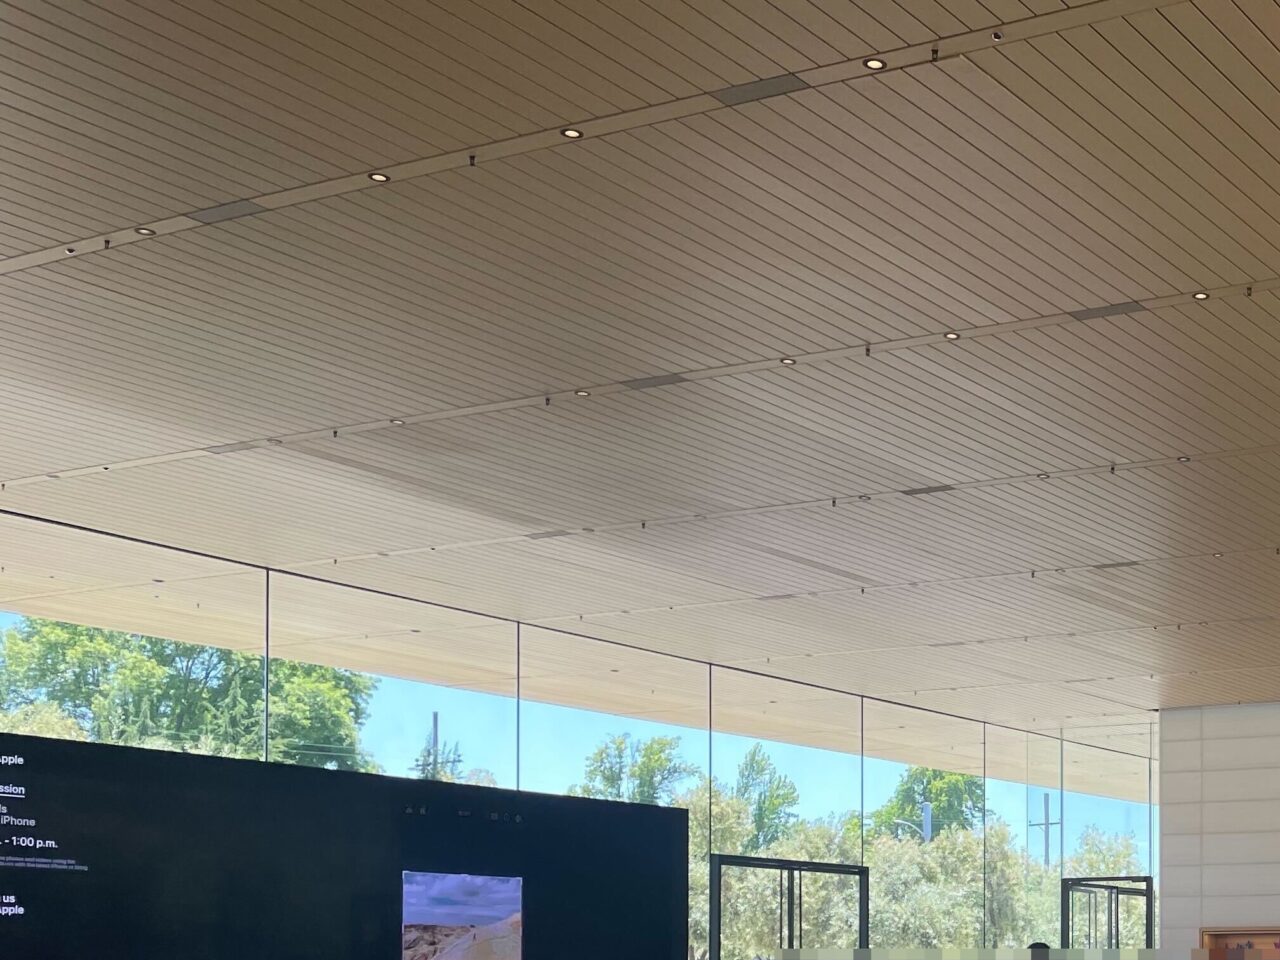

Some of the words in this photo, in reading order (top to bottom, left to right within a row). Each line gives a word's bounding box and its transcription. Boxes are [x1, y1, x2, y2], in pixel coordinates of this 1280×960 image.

[0, 755, 24, 765] pple
[1, 815, 35, 826] iPhone
[12, 836, 34, 846] 1:00
[36, 839, 58, 848] p.m.
[3, 895, 15, 903] us
[0, 905, 24, 916] pple
